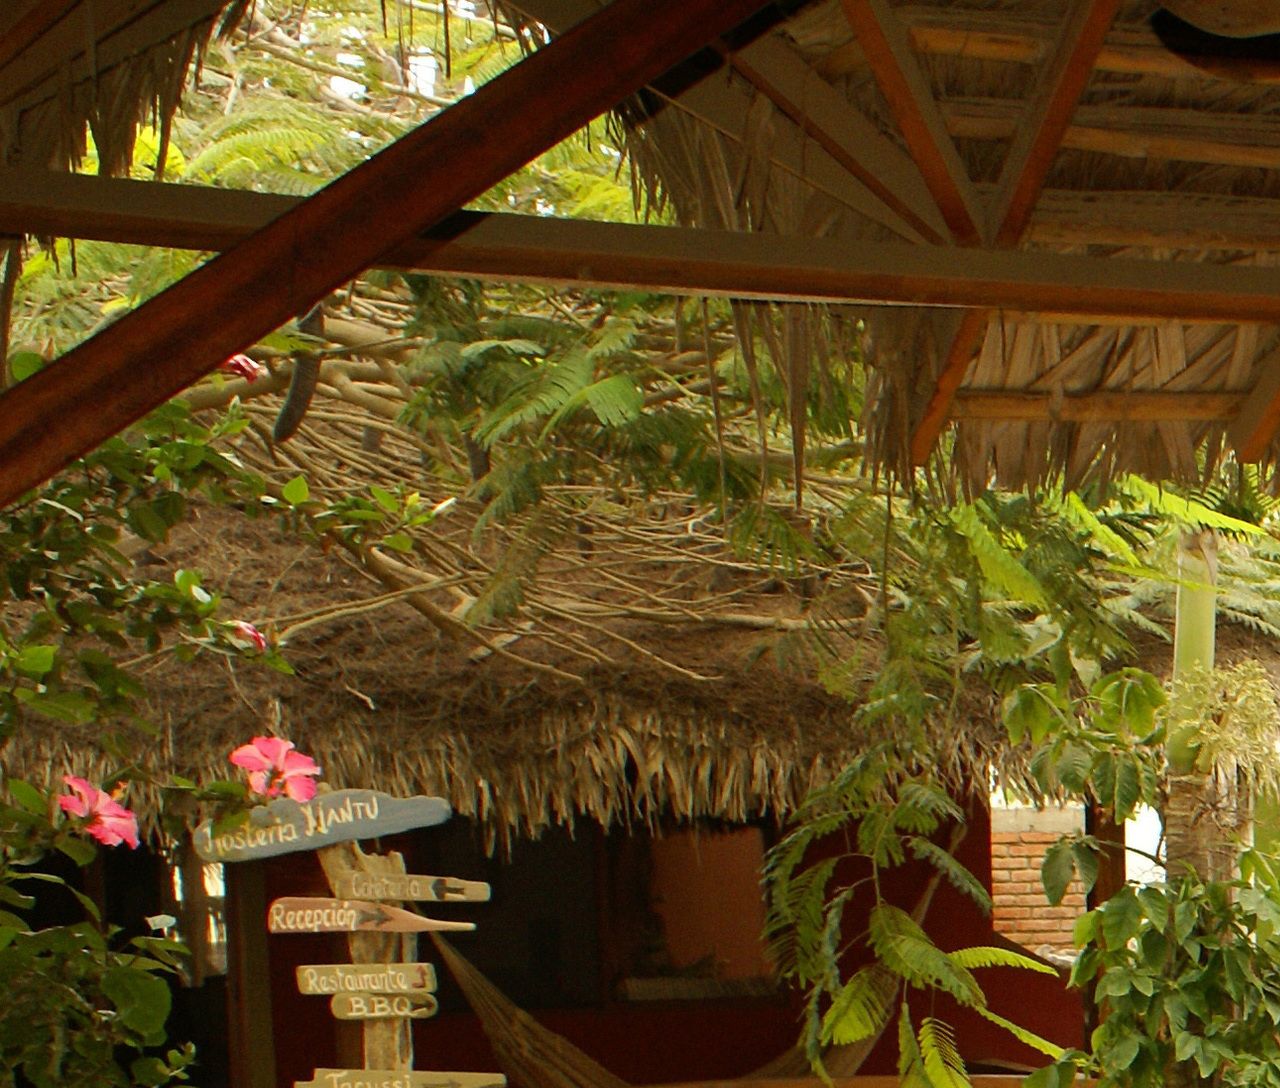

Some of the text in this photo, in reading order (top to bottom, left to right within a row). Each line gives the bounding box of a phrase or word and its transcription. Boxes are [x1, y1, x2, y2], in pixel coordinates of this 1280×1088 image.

[300, 796, 379, 837] NANTU
[270, 900, 357, 931] Recepción
[303, 966, 409, 993] Restaurante
